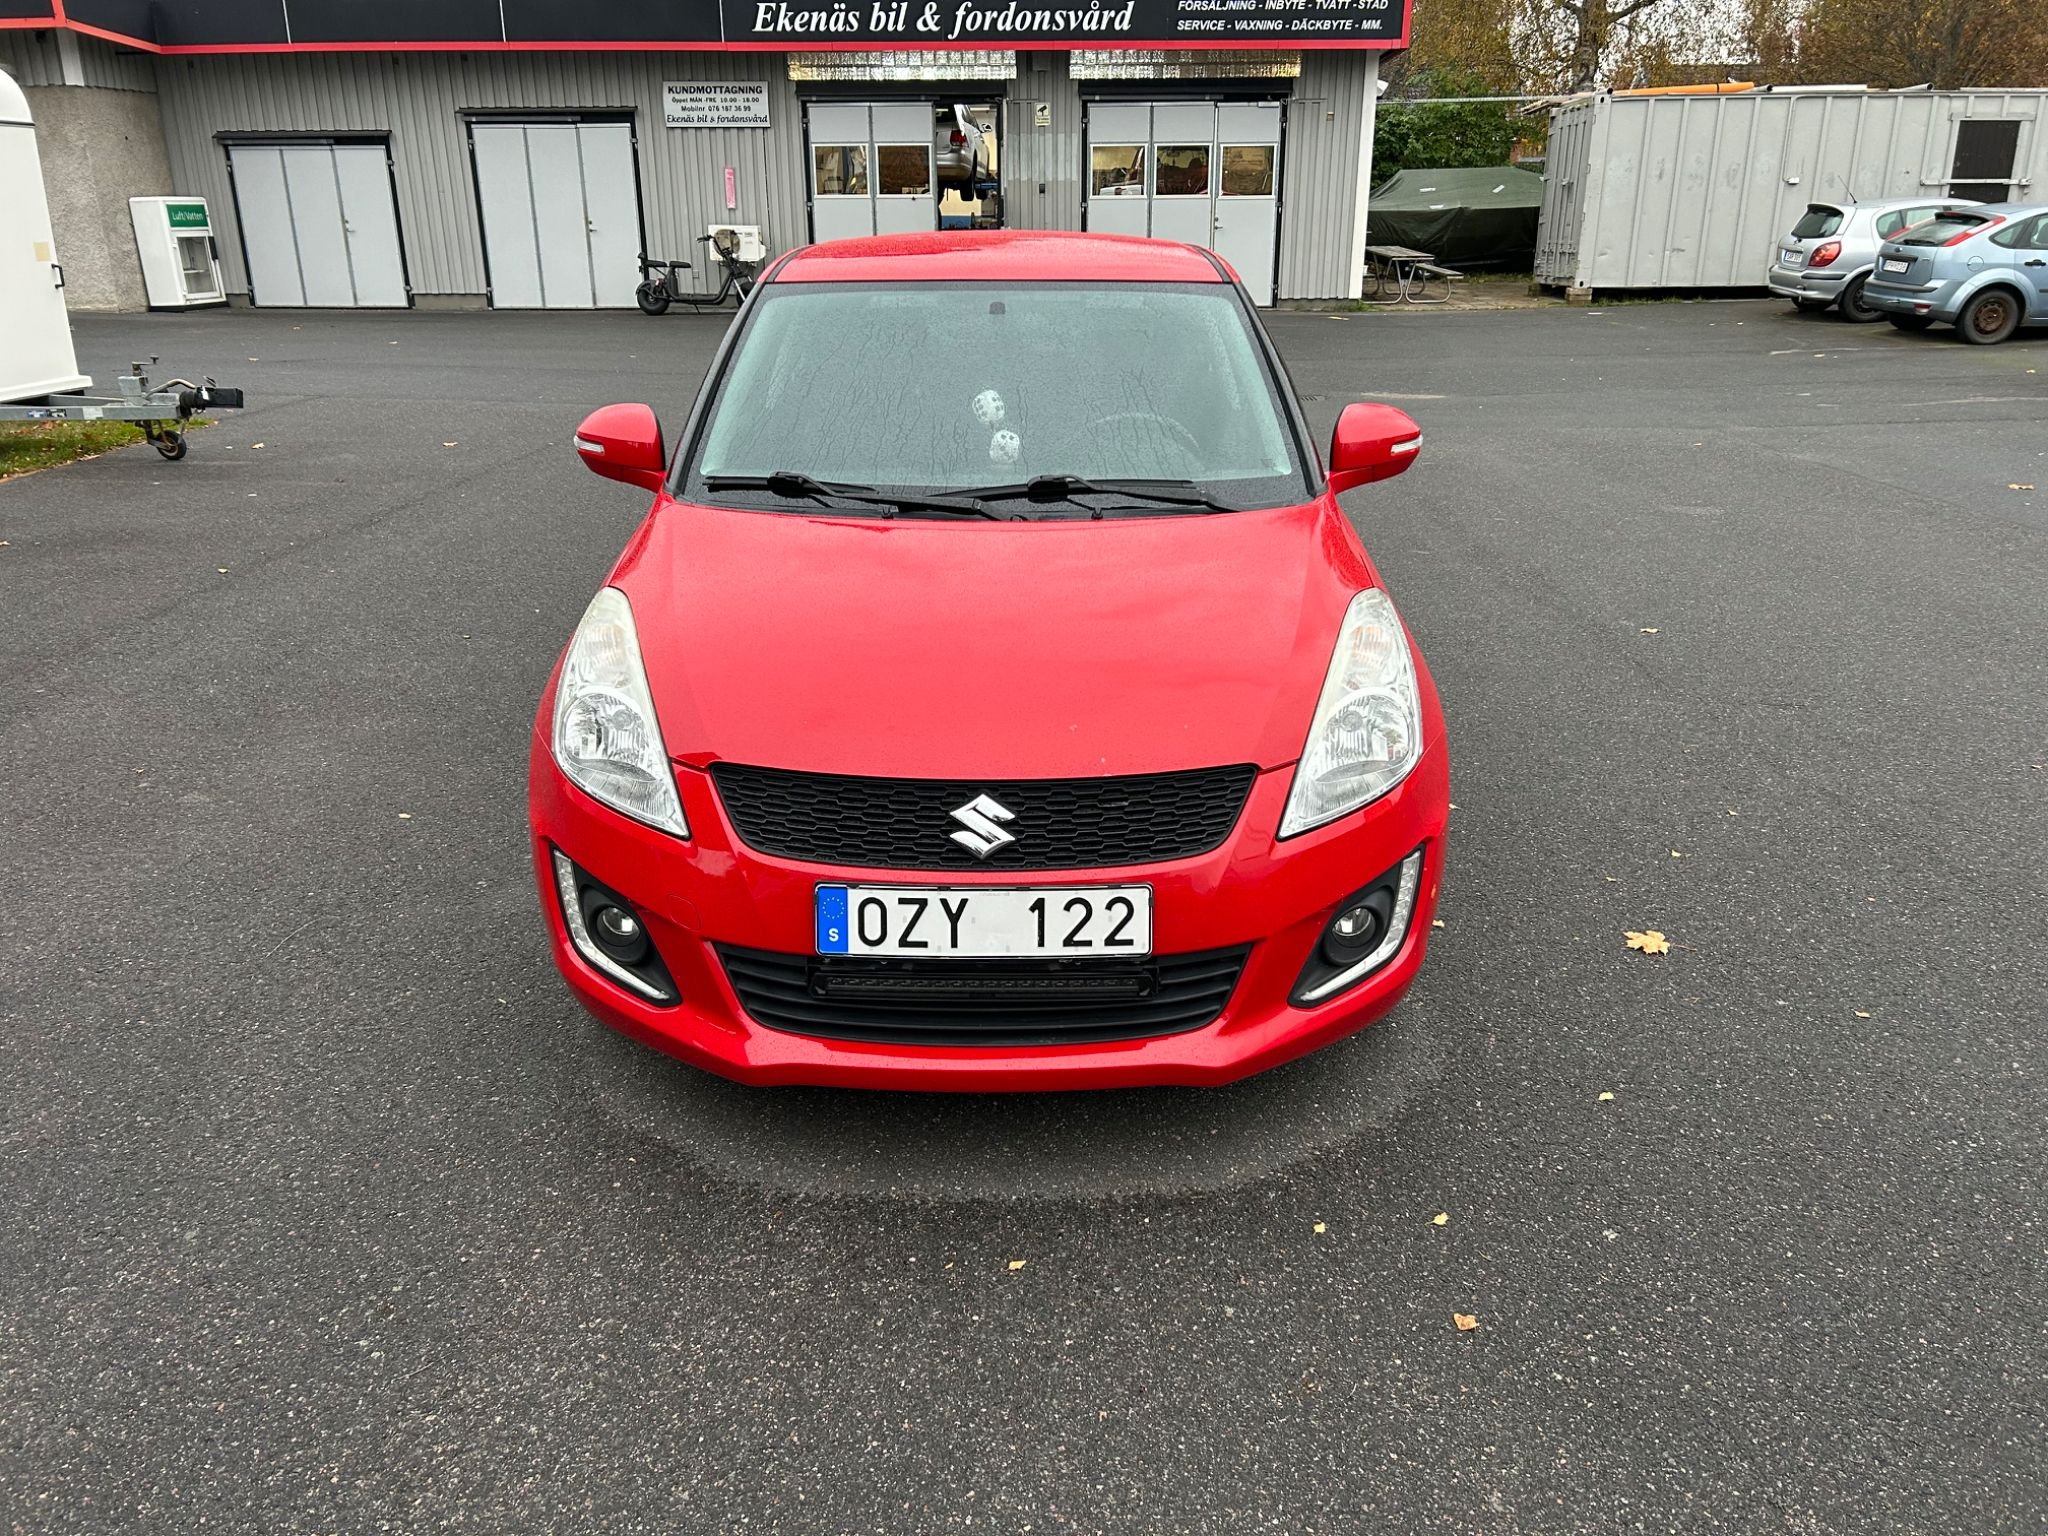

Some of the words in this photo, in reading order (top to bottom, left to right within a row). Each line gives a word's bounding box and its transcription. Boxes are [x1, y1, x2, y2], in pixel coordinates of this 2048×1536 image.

[1265, 0, 1306, 10] INBYTE
[752, 2, 859, 32] Ekenäs
[869, 2, 908, 32] bil
[916, 1, 941, 32] &
[947, 0, 1135, 40] fordonsvård
[1177, 20, 1225, 31] SERVICE
[1234, 20, 1283, 31] VAXNING
[1291, 18, 1353, 30] DÄCKBYTE
[1361, 19, 1383, 30] MM.
[668, 85, 763, 94] KUNDMOTTAGNING
[667, 114, 695, 123] Ekenäs
[697, 114, 708, 123] bil
[717, 114, 768, 124] fordonsvård
[828, 928, 839, 942] S
[858, 896, 969, 949] OZY
[1028, 896, 1135, 948] 122
